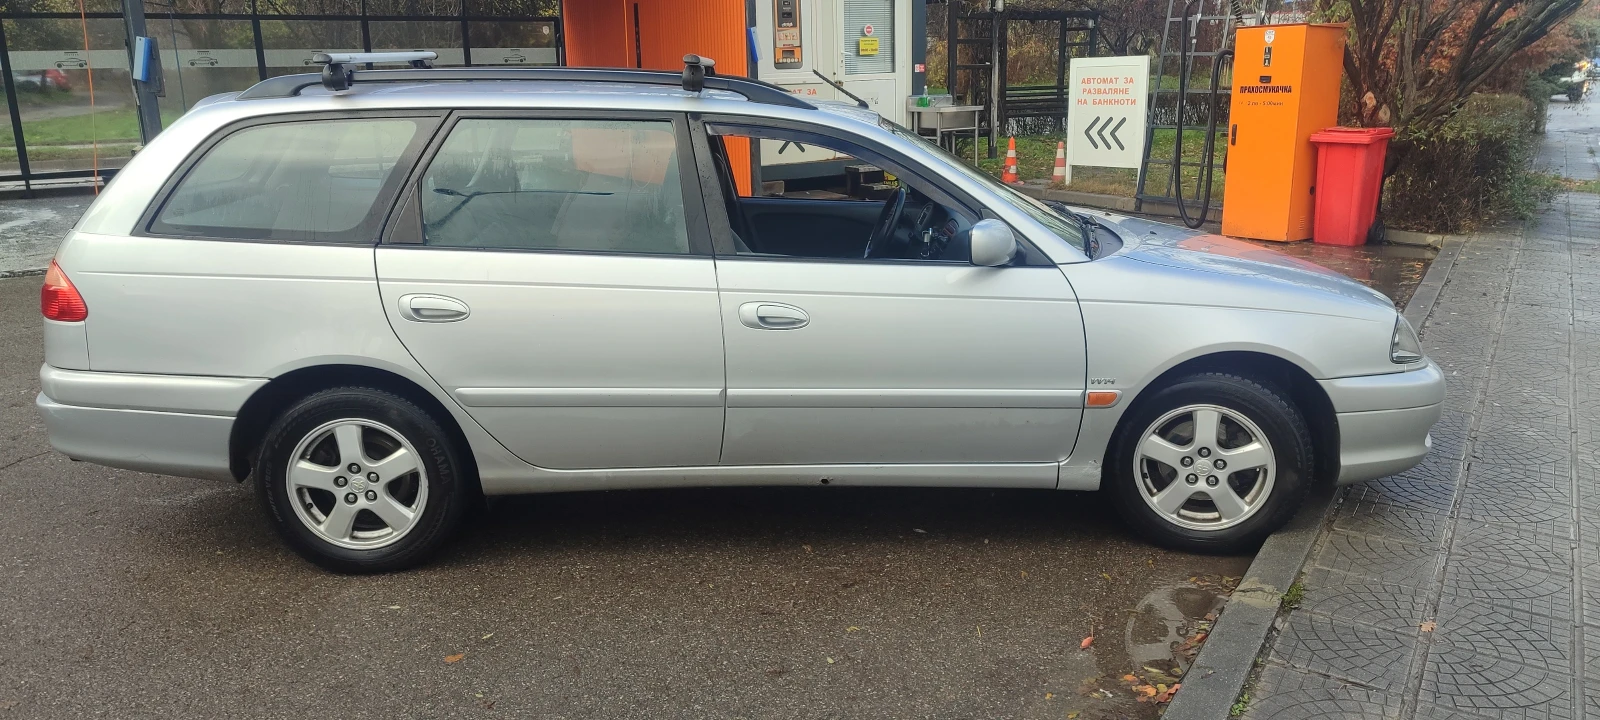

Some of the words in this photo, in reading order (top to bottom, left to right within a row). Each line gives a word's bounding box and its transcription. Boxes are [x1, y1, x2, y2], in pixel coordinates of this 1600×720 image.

[1081, 76, 1120, 85] АВТОМАТ
[1123, 76, 1135, 85] ЗА
[806, 88, 817, 96] ЗА
[1082, 87, 1130, 95] РАЗВАЛЯНЕ
[1239, 85, 1292, 94] ПРАХОСМУКАЧКА
[1077, 98, 1088, 106] НА
[1092, 98, 1137, 106] БАНКНОТИ
